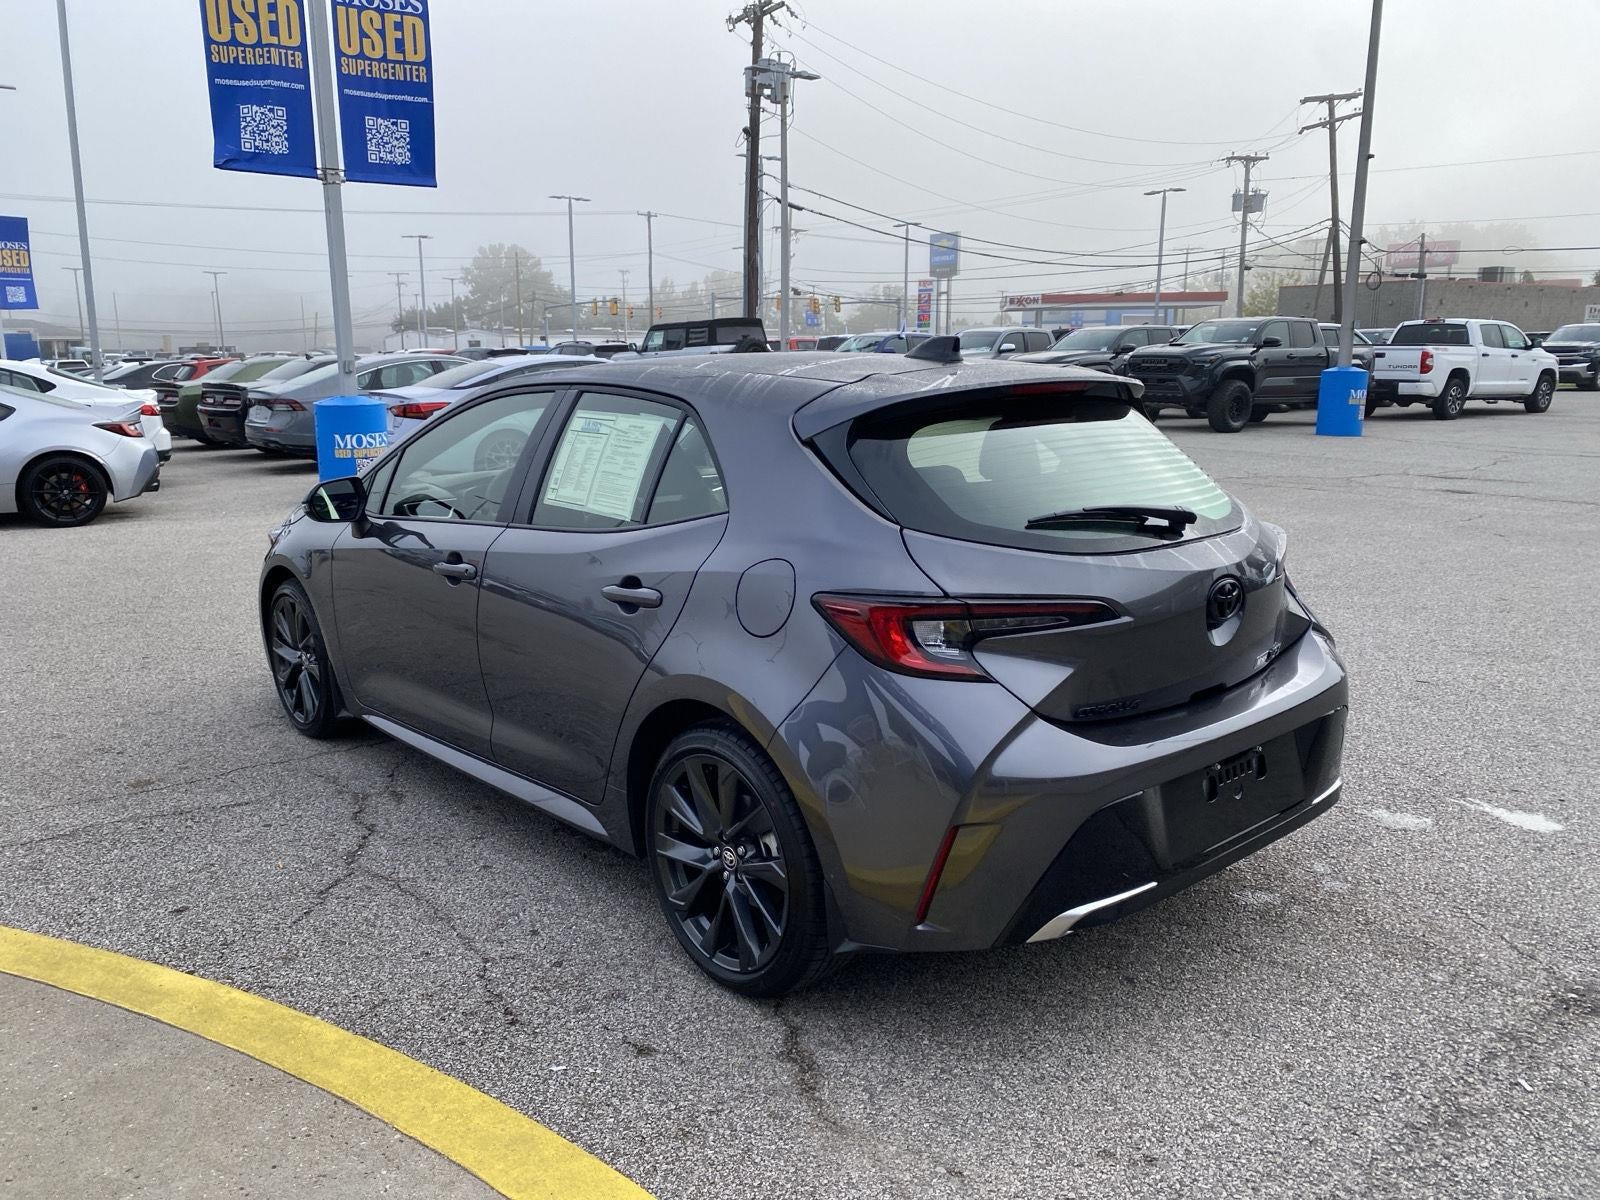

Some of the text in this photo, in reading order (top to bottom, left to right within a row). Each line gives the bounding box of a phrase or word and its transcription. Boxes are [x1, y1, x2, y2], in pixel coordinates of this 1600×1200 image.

[206, 0, 301, 47] USED
[336, 5, 426, 62] USED
[211, 44, 303, 69] SUPERCENTER
[341, 57, 427, 83] SUPERCENTER
[214, 78, 305, 90] mosesusedsupercenter.com
[343, 88, 428, 103] mosesusedsupercenter.com
[0, 241, 28, 249] OSES
[1009, 295, 1040, 307] EXXON
[333, 432, 388, 449] MOSES
